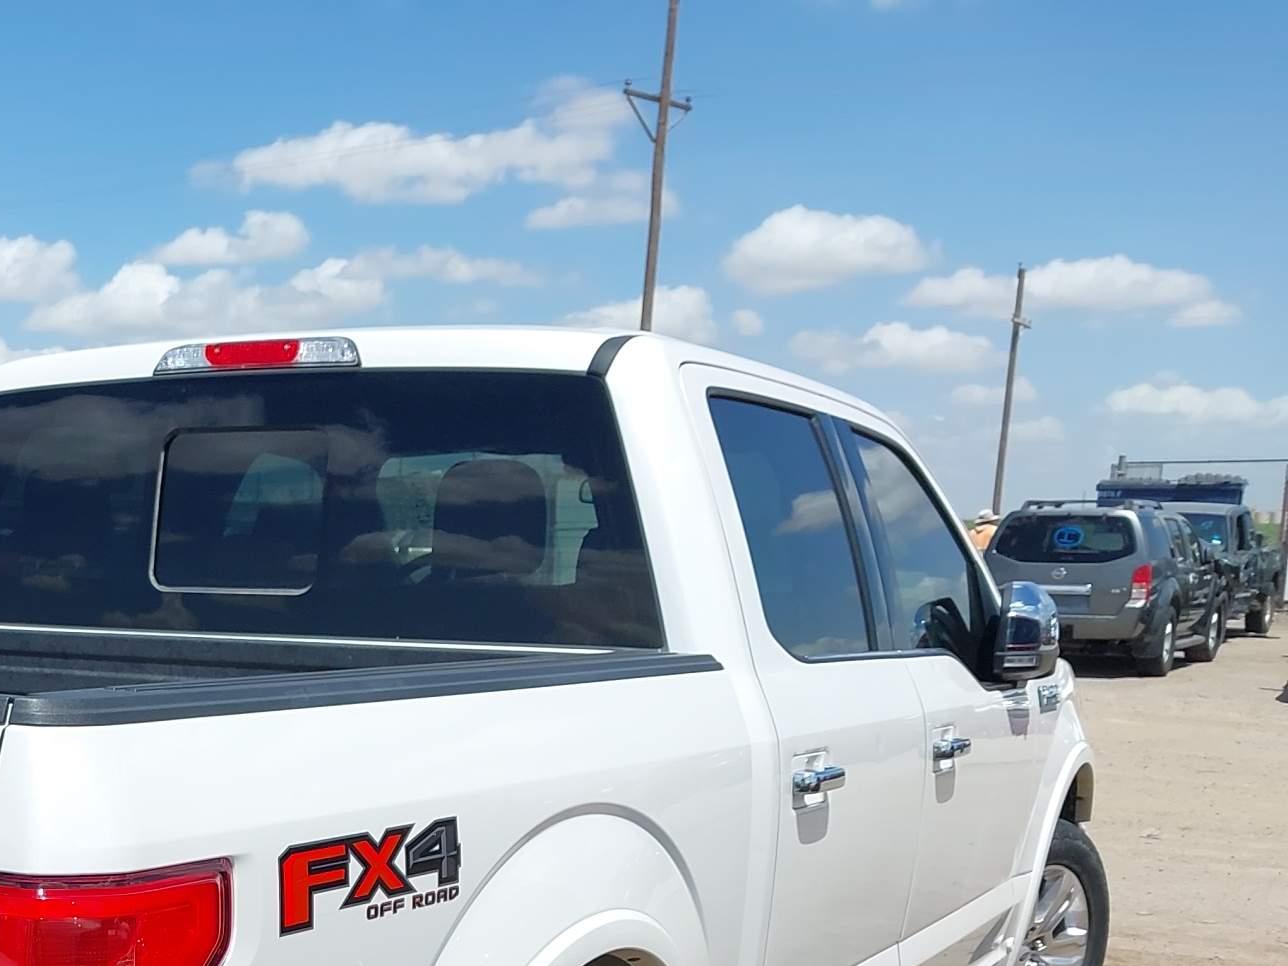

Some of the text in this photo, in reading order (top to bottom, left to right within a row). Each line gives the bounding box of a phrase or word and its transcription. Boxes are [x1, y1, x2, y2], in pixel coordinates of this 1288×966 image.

[278, 815, 461, 937] FX4
[366, 885, 460, 921] OFF ROAD
